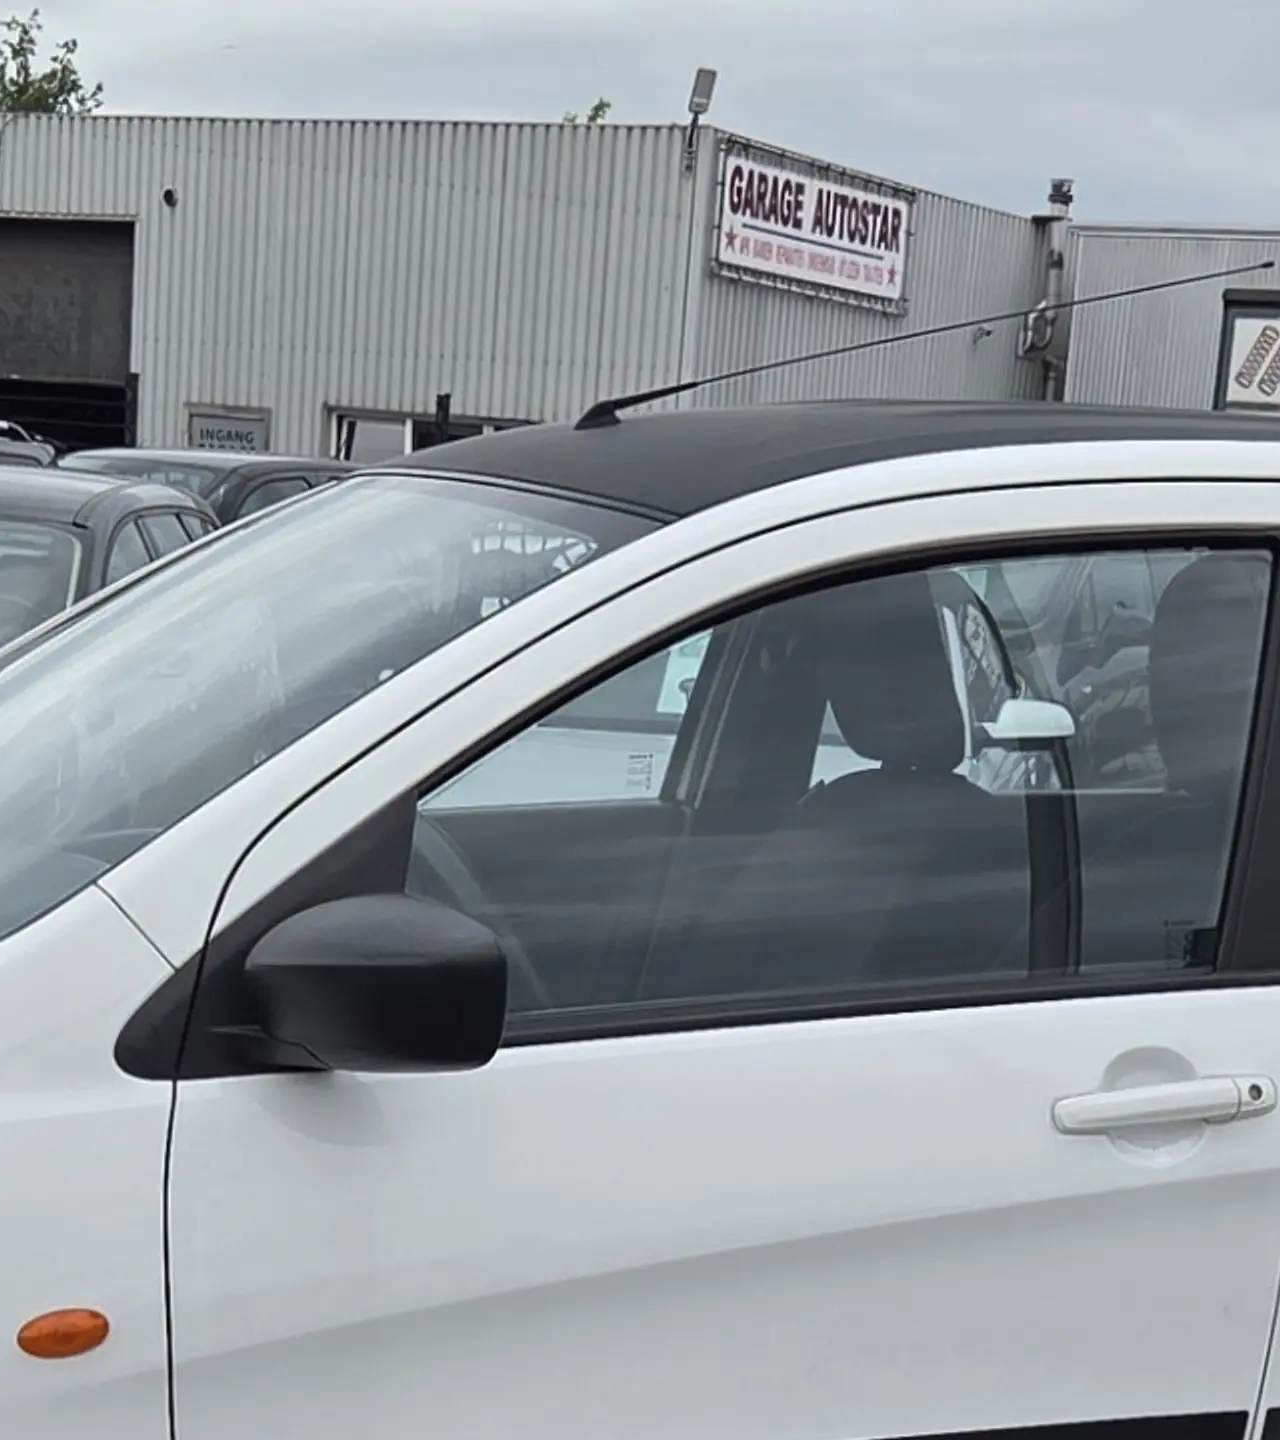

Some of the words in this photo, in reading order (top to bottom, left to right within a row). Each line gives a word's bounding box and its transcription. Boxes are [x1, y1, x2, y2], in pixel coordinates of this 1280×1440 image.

[729, 165, 805, 230] GARAGE
[811, 188, 902, 253] AUTOSTAR
[200, 428, 254, 444] INGANG
